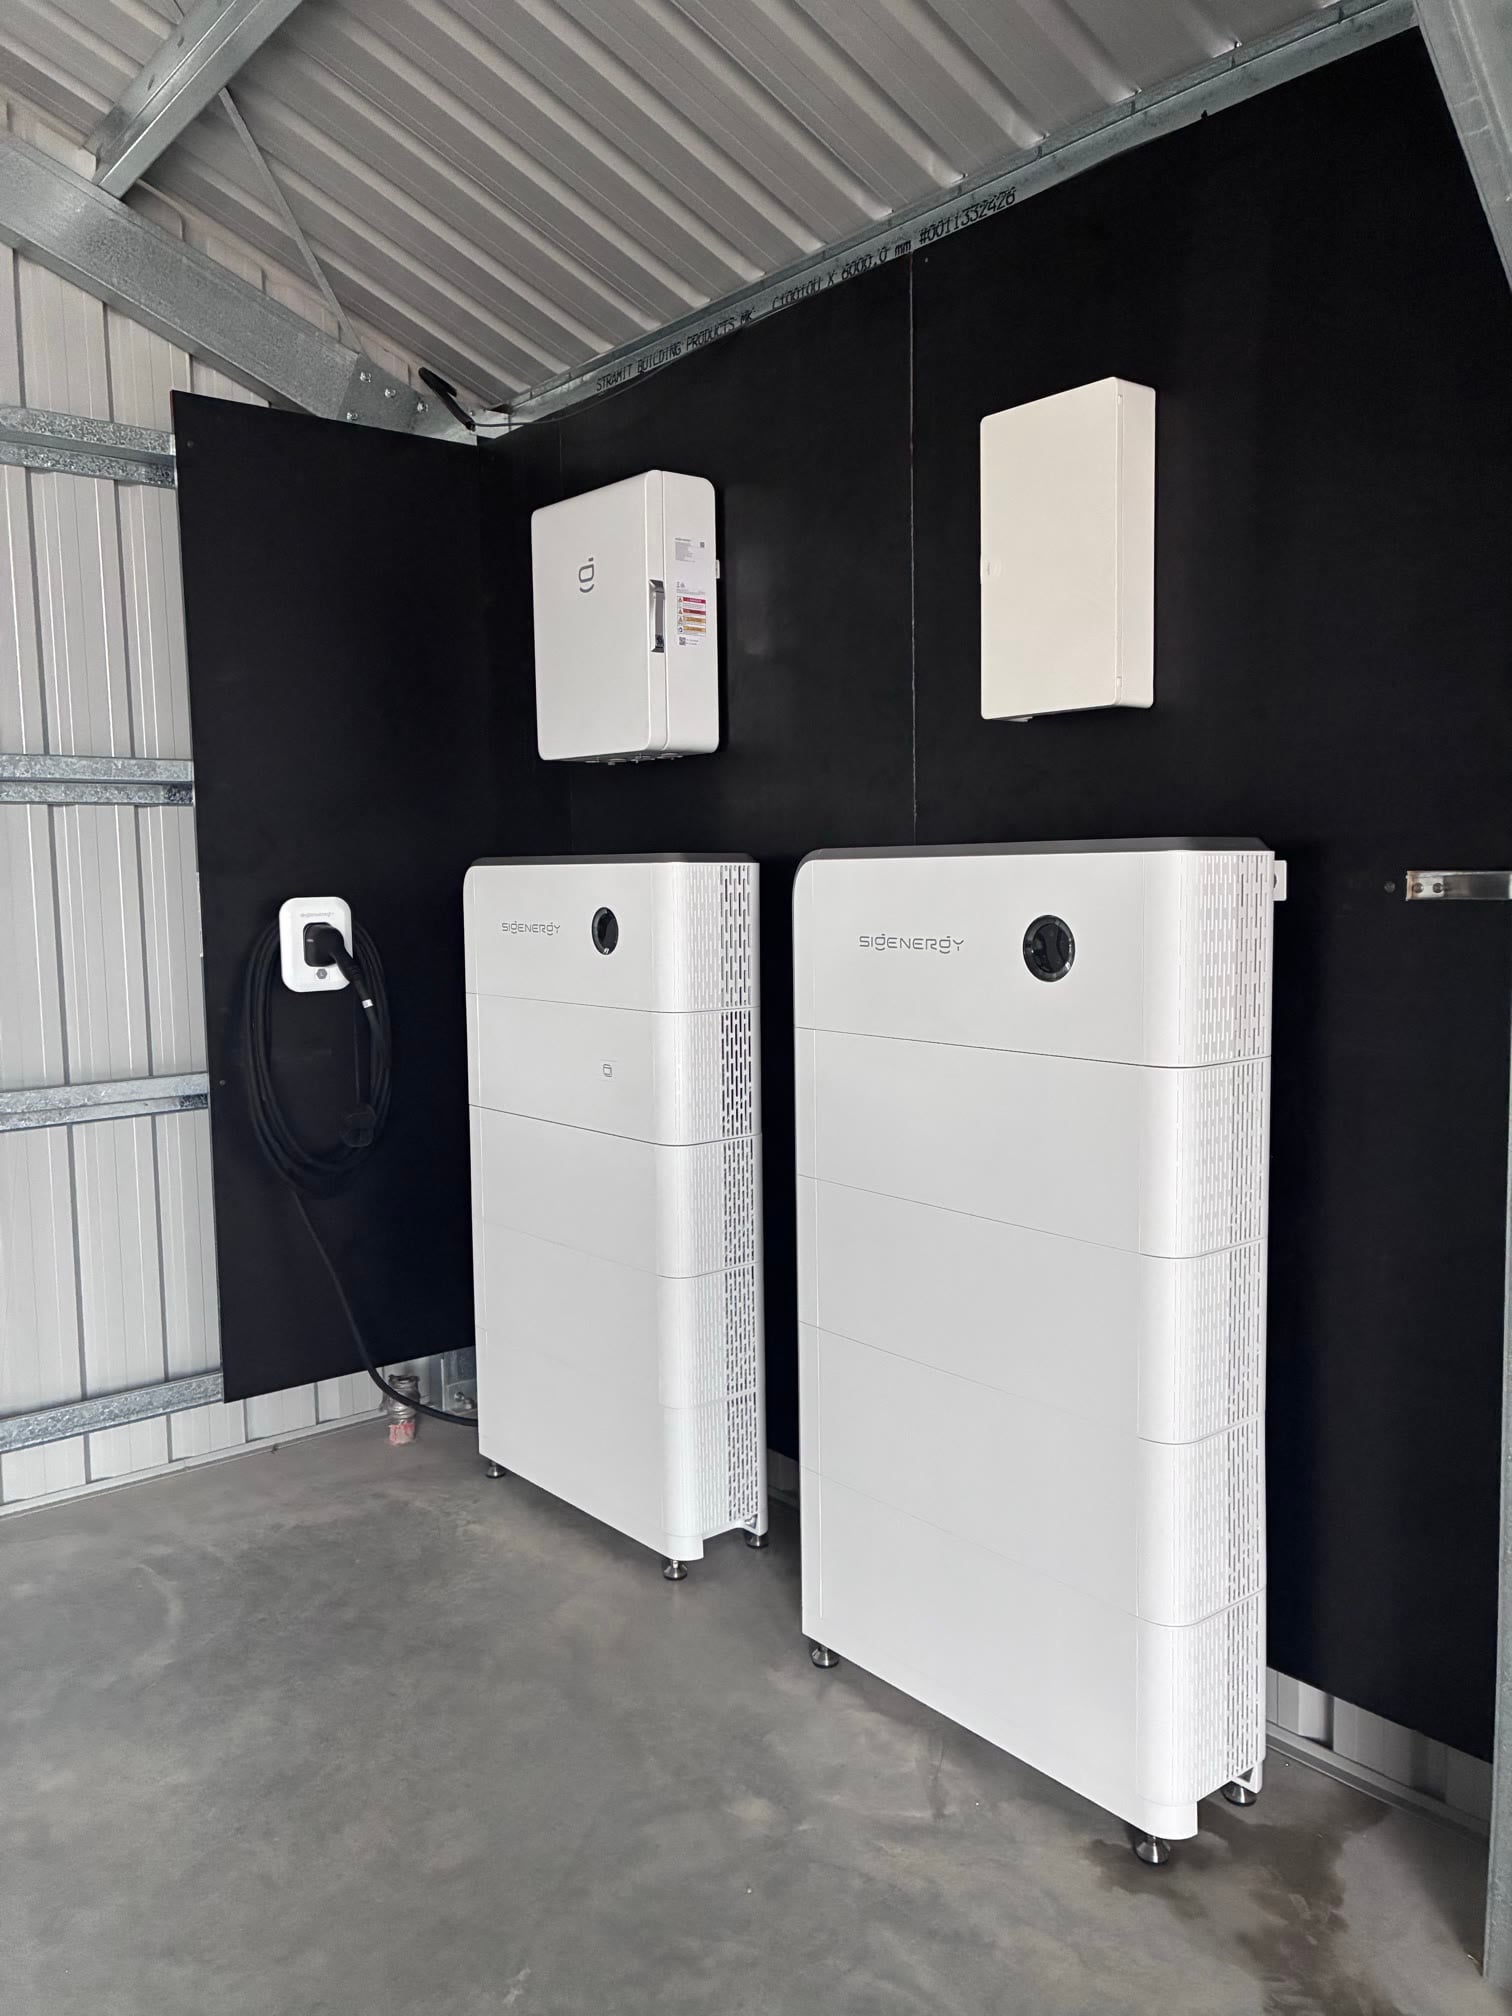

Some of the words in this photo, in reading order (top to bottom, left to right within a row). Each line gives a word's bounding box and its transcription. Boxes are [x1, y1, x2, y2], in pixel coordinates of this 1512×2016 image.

[596, 363, 632, 391] STRAMIT
[637, 341, 682, 375] BUILDING
[686, 316, 737, 351] PRODUCTS
[827, 270, 837, 287] X
[842, 246, 889, 281] 6000.0
[895, 240, 912, 257] mm
[919, 186, 1016, 245] #0011332426
[501, 920, 561, 936] SIGENERGY
[859, 933, 965, 954] SIGENERGY
